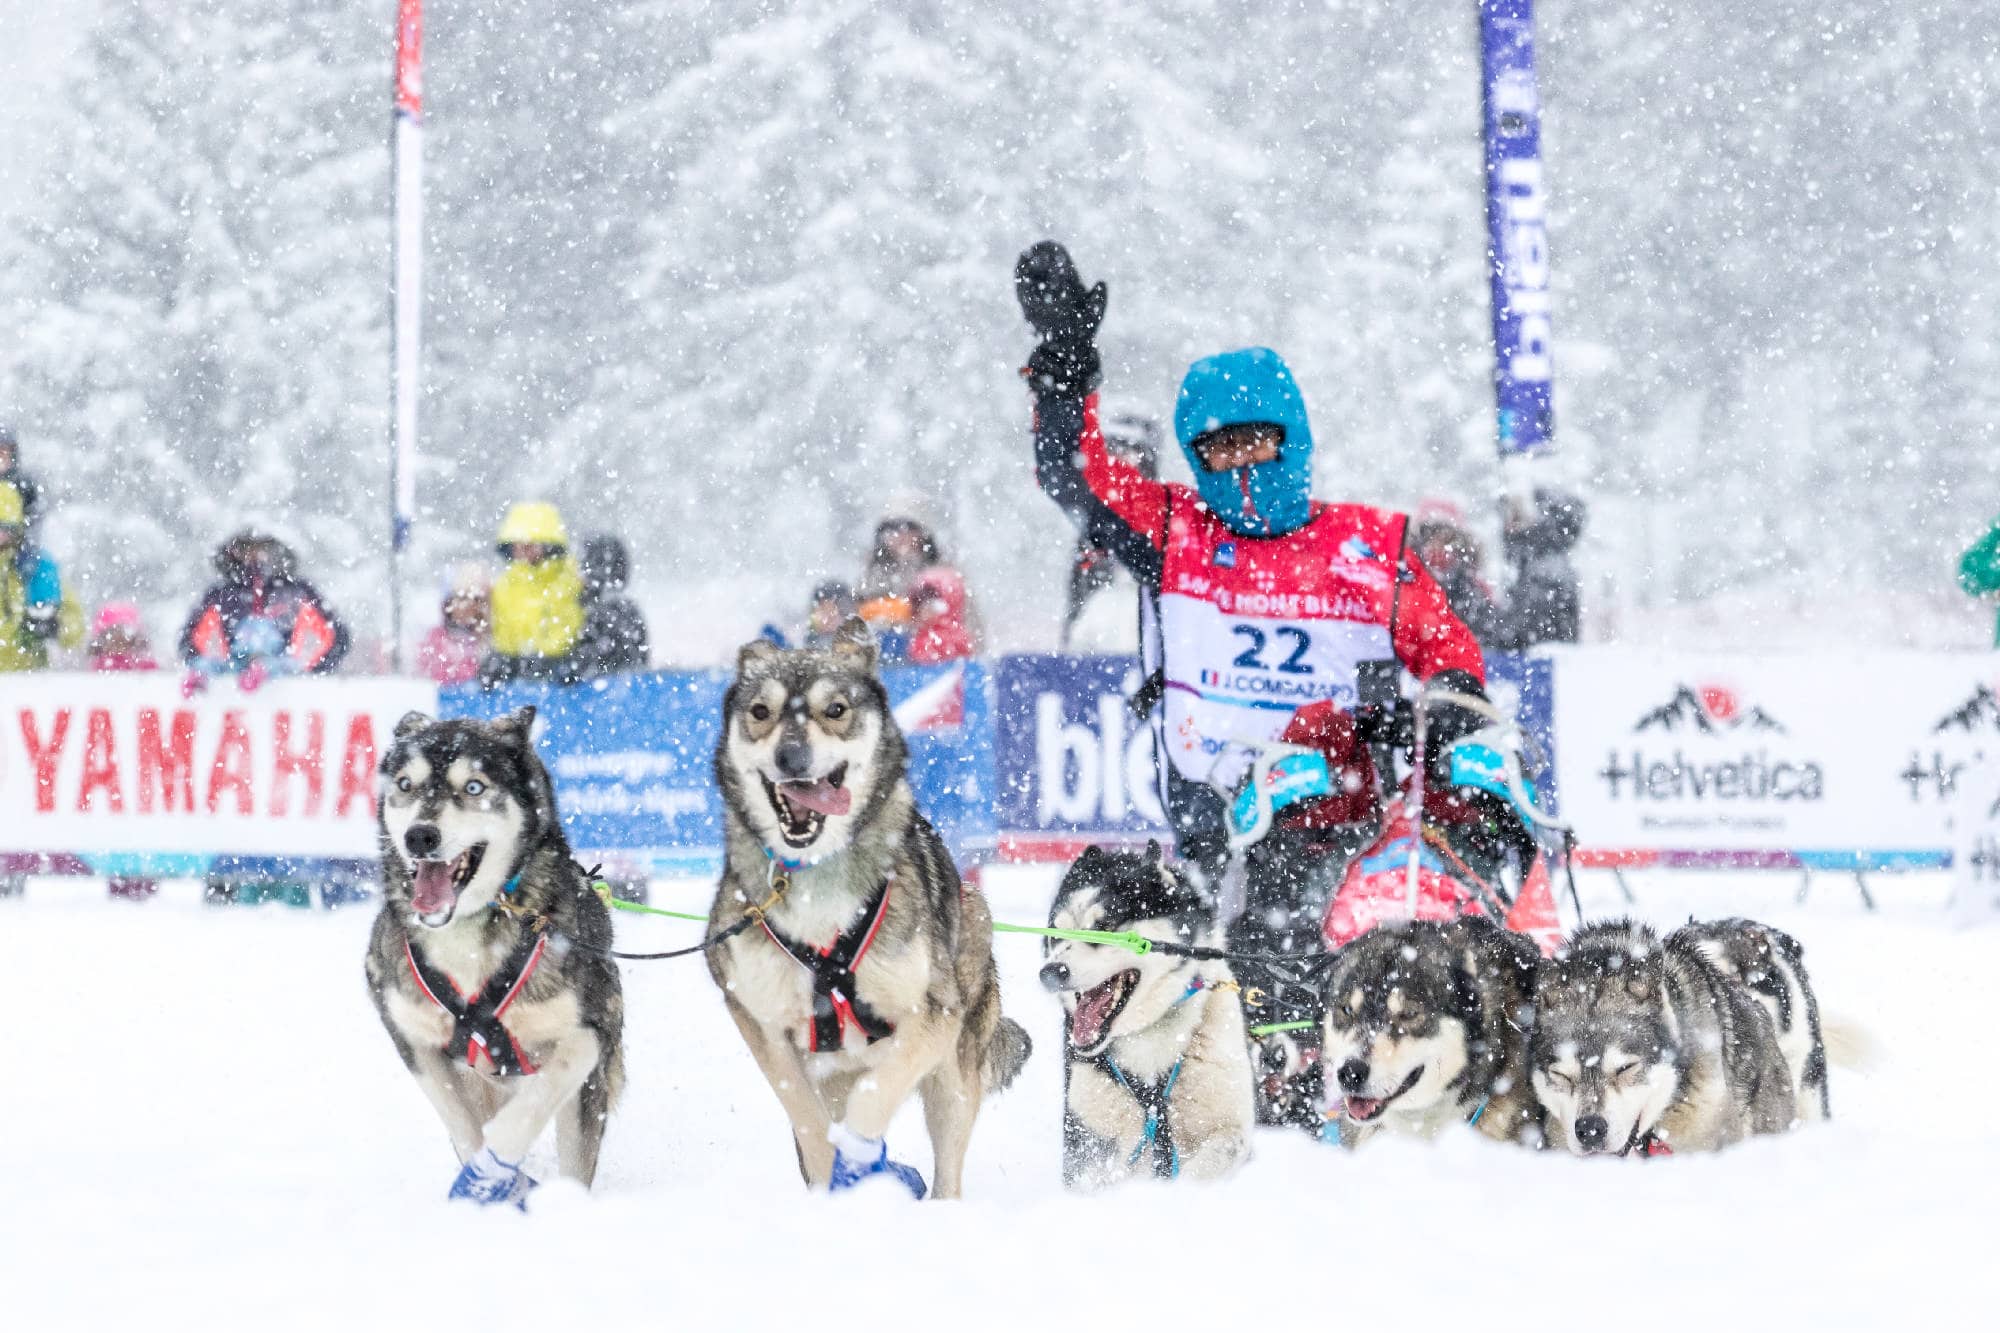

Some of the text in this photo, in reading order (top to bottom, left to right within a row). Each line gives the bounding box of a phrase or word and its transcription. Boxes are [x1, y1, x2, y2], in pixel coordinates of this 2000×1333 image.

[1232, 623, 1314, 674] 22
[18, 707, 378, 816] YAMAHA
[1600, 747, 1824, 800] Helvetica
